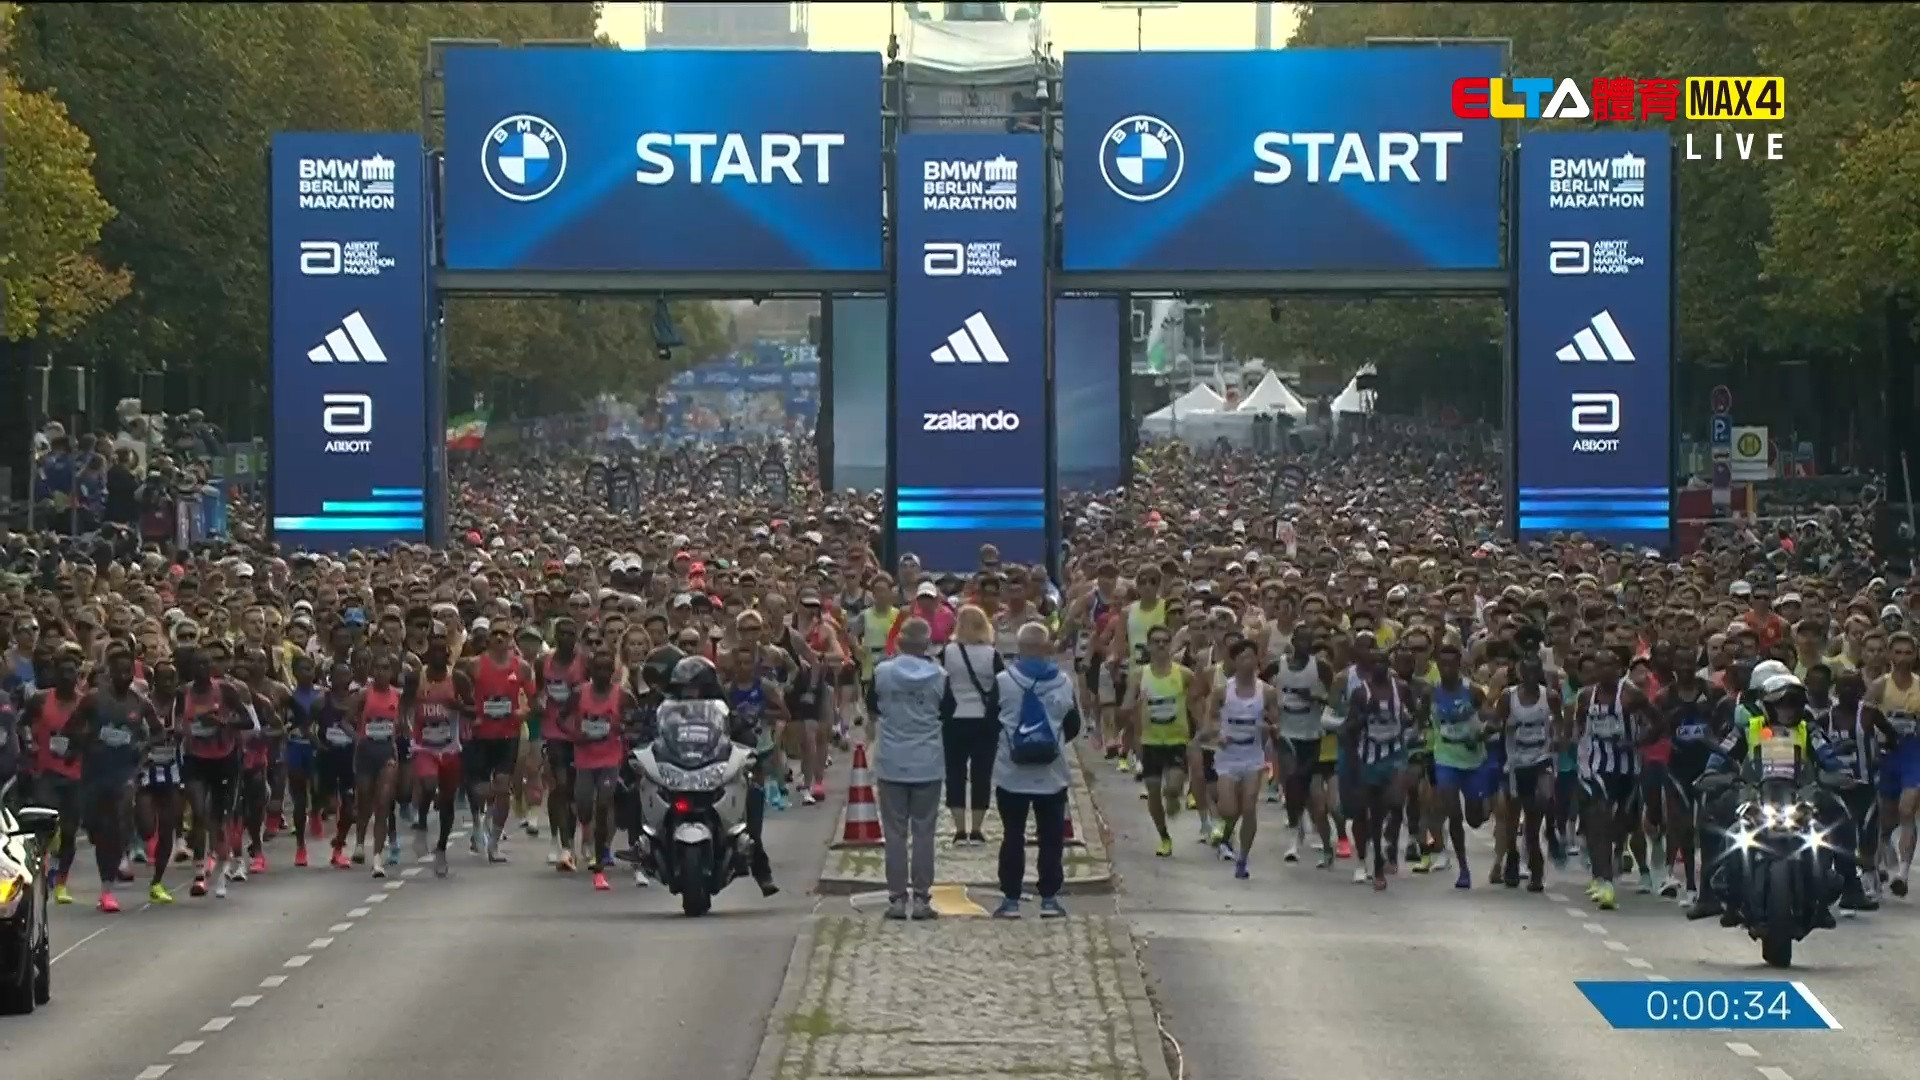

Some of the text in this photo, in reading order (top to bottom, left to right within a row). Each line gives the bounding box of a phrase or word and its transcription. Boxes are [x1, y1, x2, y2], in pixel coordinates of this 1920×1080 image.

[493, 119, 555, 144] BMW
[1111, 120, 1172, 144] BMW
[636, 132, 845, 184] START
[1253, 132, 1463, 184] START
[300, 159, 359, 179] BMW
[924, 161, 982, 180] BMW
[1550, 158, 1609, 178] BMW
[300, 180, 360, 193] BERLIN
[924, 181, 983, 194] BERLIN
[1550, 179, 1609, 192] BERLIN
[300, 195, 395, 209] MARATHON
[924, 196, 1017, 210] MARATHON
[1550, 194, 1644, 208] MARATHON
[923, 410, 1020, 431] zalando
[324, 440, 371, 452] ABBOTT
[1572, 439, 1620, 451] ABBOTT
